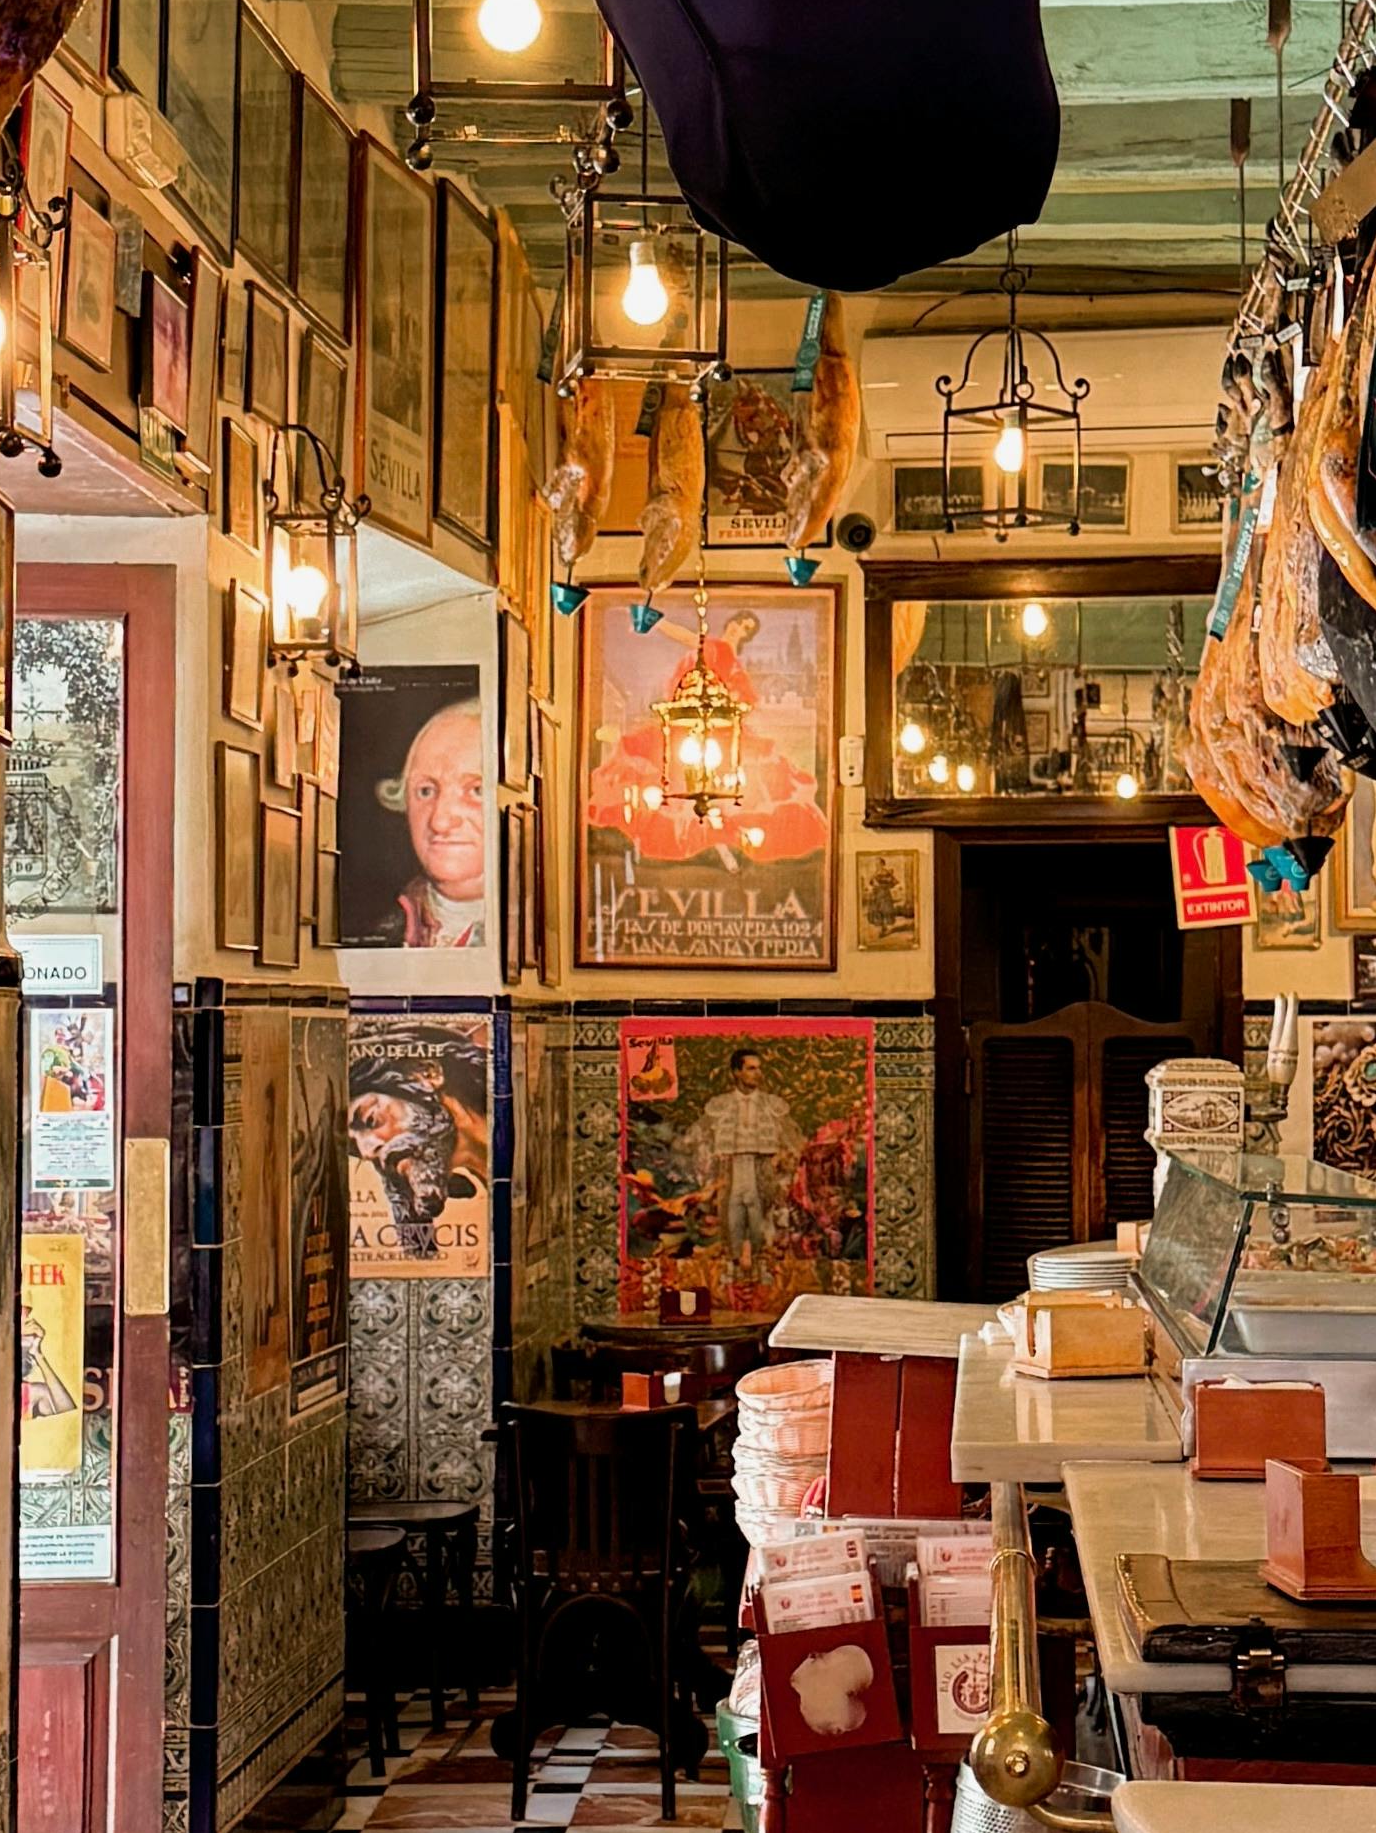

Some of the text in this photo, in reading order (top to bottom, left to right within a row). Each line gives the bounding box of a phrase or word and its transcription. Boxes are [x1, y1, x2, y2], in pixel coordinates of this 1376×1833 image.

[370, 438, 422, 504] SEVILLA
[602, 888, 808, 919] SEVILLA
[1186, 898, 1246, 916] EXTINTOR
[661, 919, 824, 938] DE PRIMAVERA 1924
